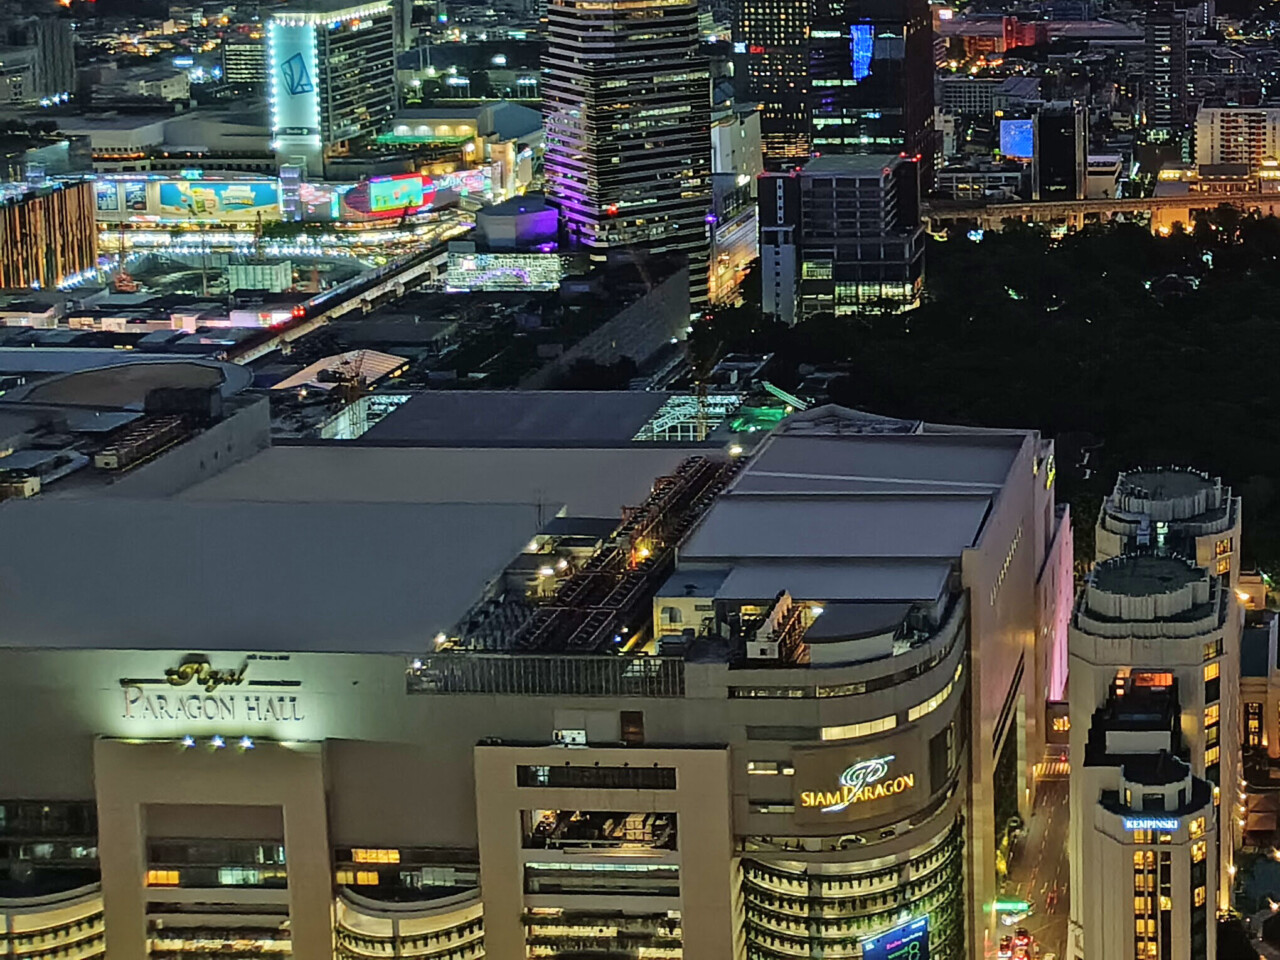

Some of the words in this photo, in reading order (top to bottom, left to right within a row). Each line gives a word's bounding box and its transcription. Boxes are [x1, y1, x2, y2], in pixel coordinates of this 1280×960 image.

[122, 685, 236, 720] PARAGON
[245, 695, 304, 721] HALL
[801, 790, 841, 807] SIAM
[841, 773, 915, 805] PARAGON
